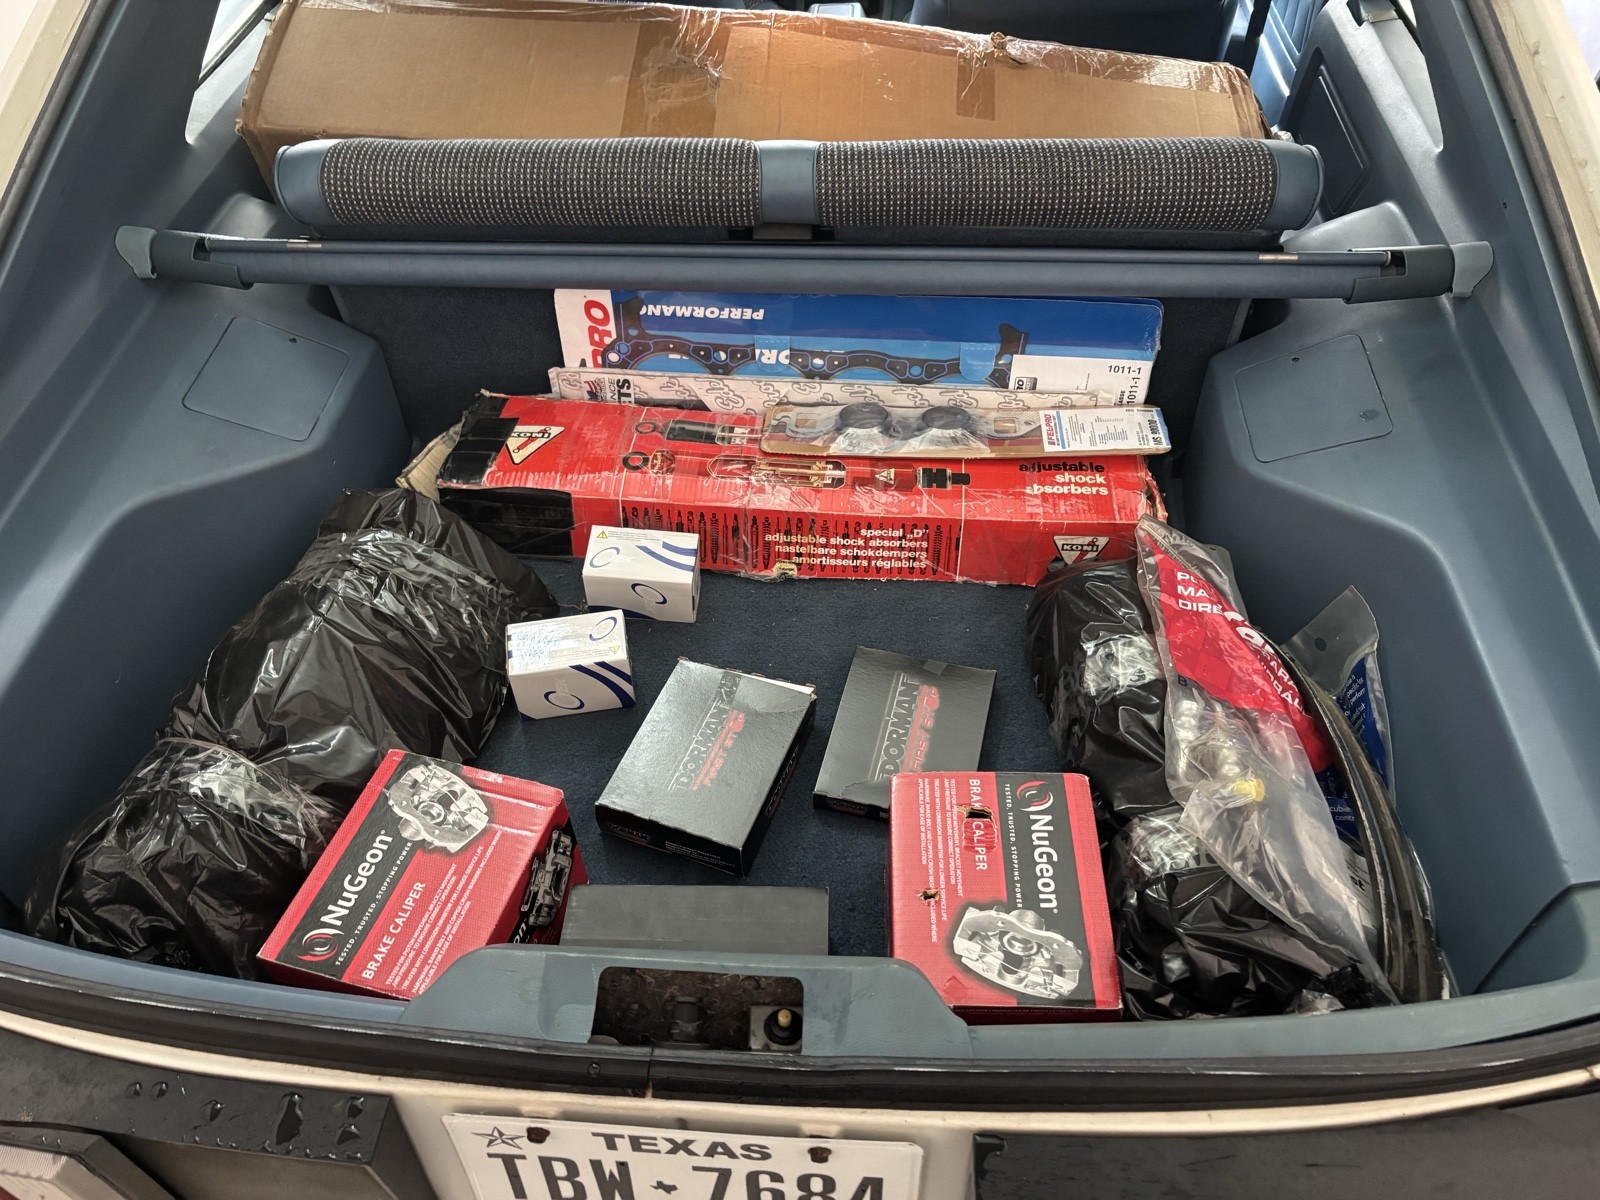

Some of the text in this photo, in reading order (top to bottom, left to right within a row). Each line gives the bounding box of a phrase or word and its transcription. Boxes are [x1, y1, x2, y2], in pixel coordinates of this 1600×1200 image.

[1108, 364, 1142, 375] 1011-1
[1127, 376, 1141, 405] 1011-1
[1019, 462, 1104, 472] adjustable
[1055, 472, 1106, 484] shock
[1026, 483, 1109, 495] absorbers
[765, 533, 928, 548] adjustable shock absorbers
[860, 528, 903, 539] special
[775, 544, 927, 559] nastelbare schokdempers
[793, 555, 926, 569] amortisseurs réglables
[877, 681, 920, 776] DORMAN
[969, 779, 987, 871] BRAK CALIPER
[1029, 814, 1058, 908] NuGeon
[320, 834, 393, 926] NuGeon
[1011, 846, 1019, 882] STOPPING
[1015, 884, 1023, 908] POWER
[335, 841, 413, 965] TESTED, TRUSTED, STOPPING POWER
[362, 881, 426, 979] BRAKE CALIPER
[591, 1131, 773, 1161] TEXAS
[487, 1152, 884, 1200] TBW 7684
